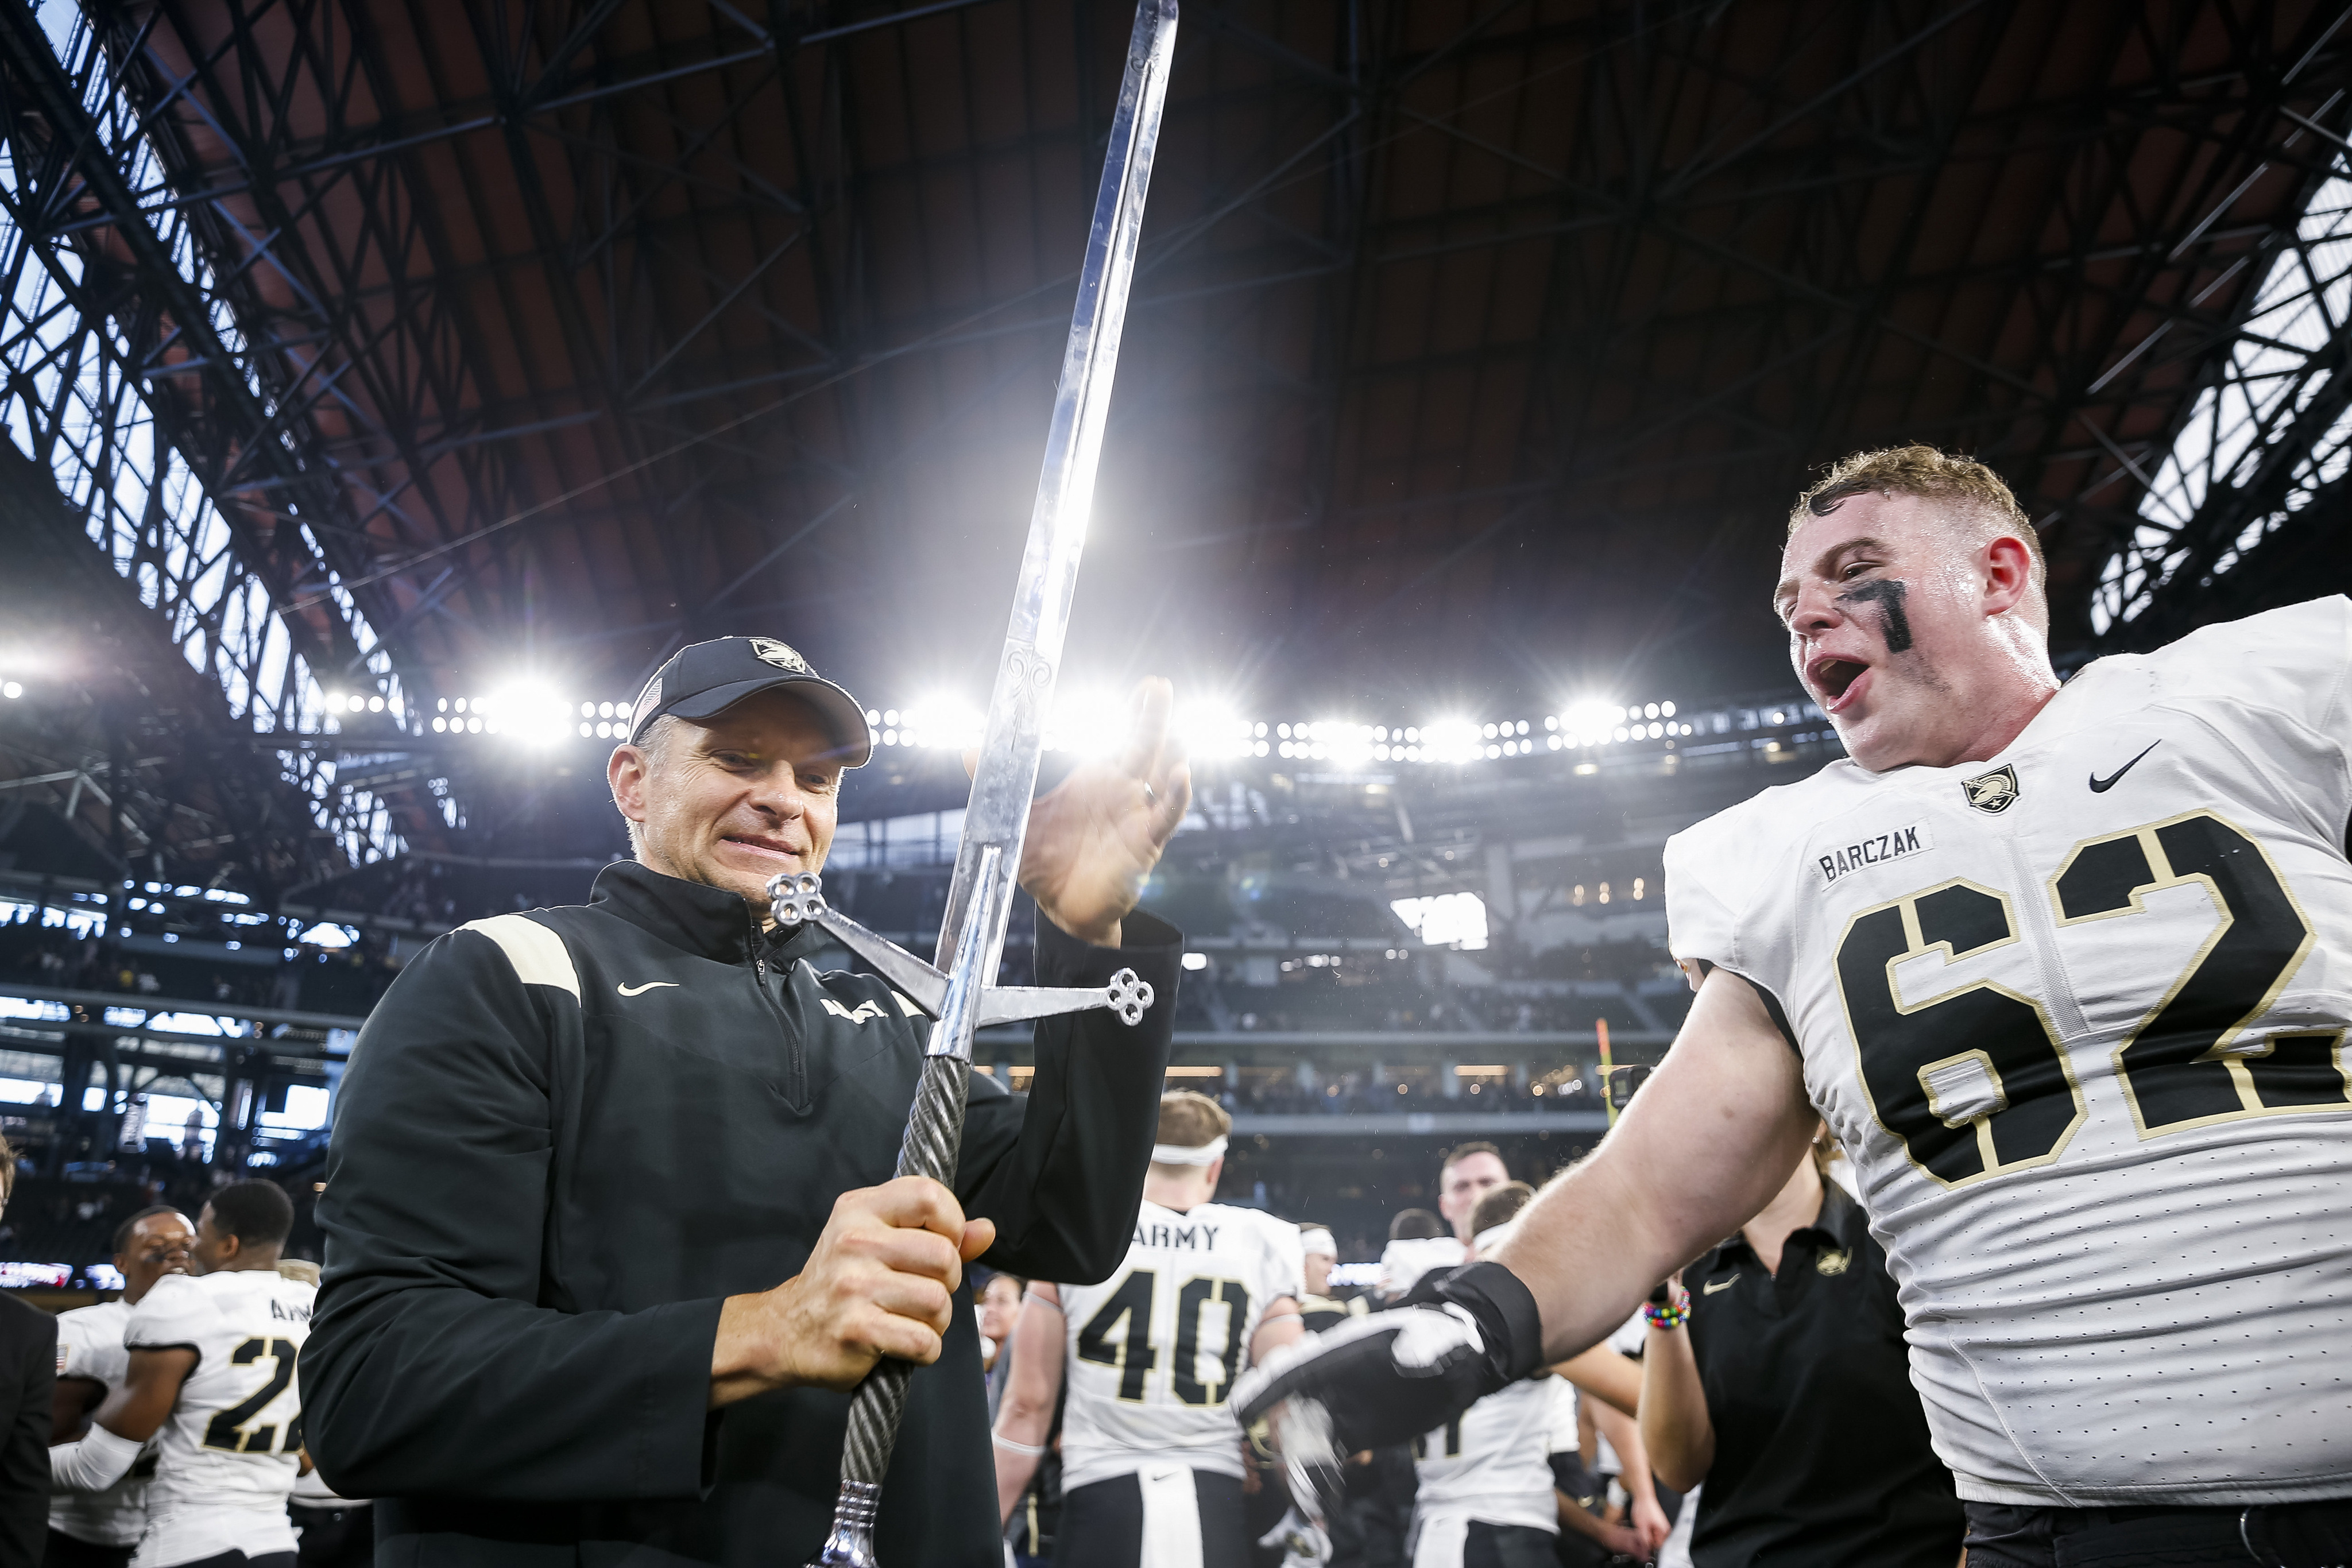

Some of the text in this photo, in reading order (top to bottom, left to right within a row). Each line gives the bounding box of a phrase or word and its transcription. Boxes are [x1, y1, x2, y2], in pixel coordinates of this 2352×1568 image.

[1819, 826, 1920, 882] BARCZAK
[1833, 808, 2352, 1190] 62
[1132, 1224, 1219, 1250] ARMY
[1077, 1268, 1250, 1407] 40
